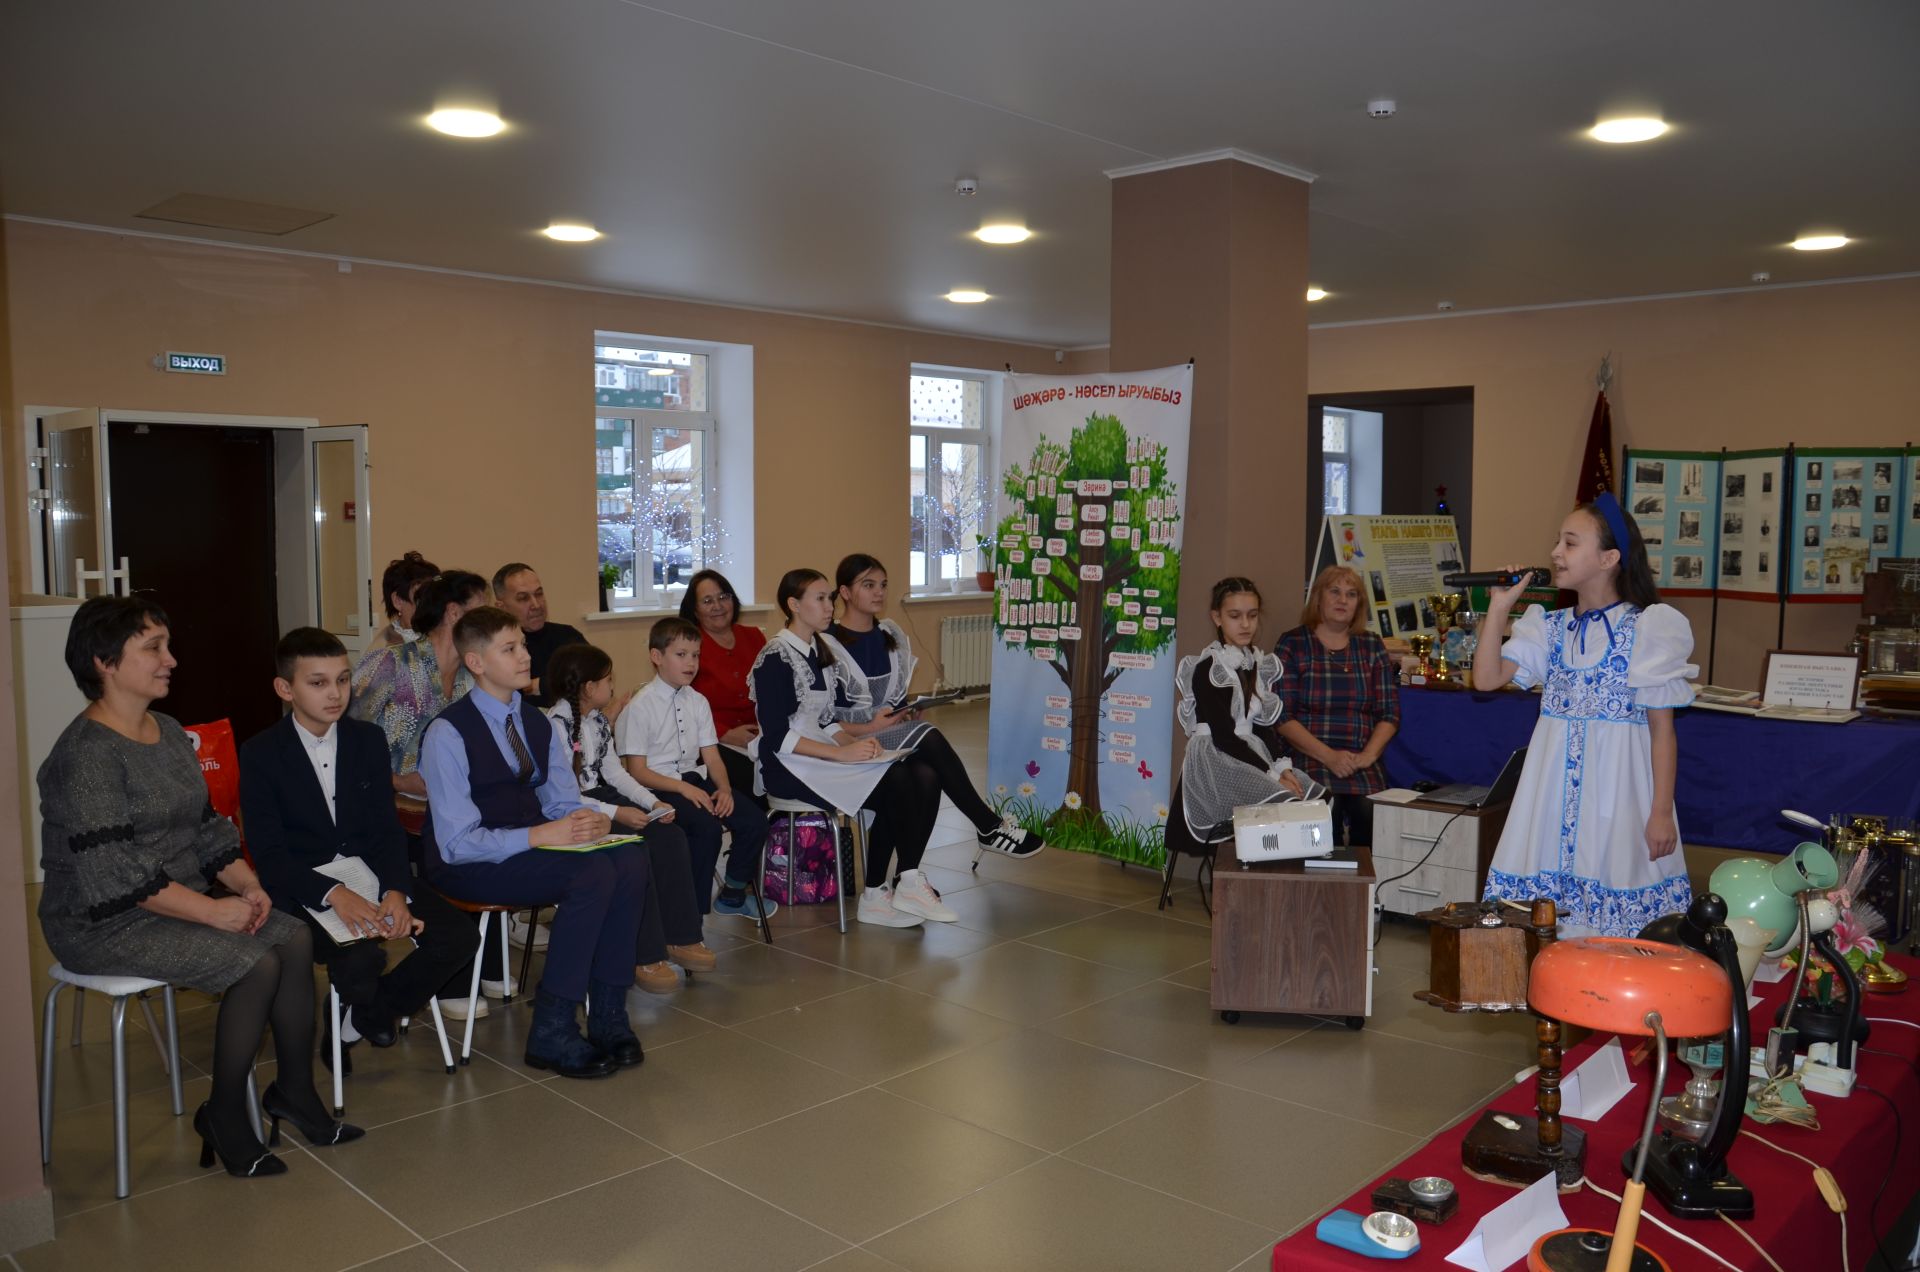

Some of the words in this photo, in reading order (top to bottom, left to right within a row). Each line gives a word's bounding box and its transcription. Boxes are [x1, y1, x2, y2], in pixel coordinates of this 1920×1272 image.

[172, 356, 219, 371] ВЫХОД
[1075, 385, 1116, 398] НӘСЕЛ
[1118, 385, 1182, 405] ЫРУЫБЫЗ
